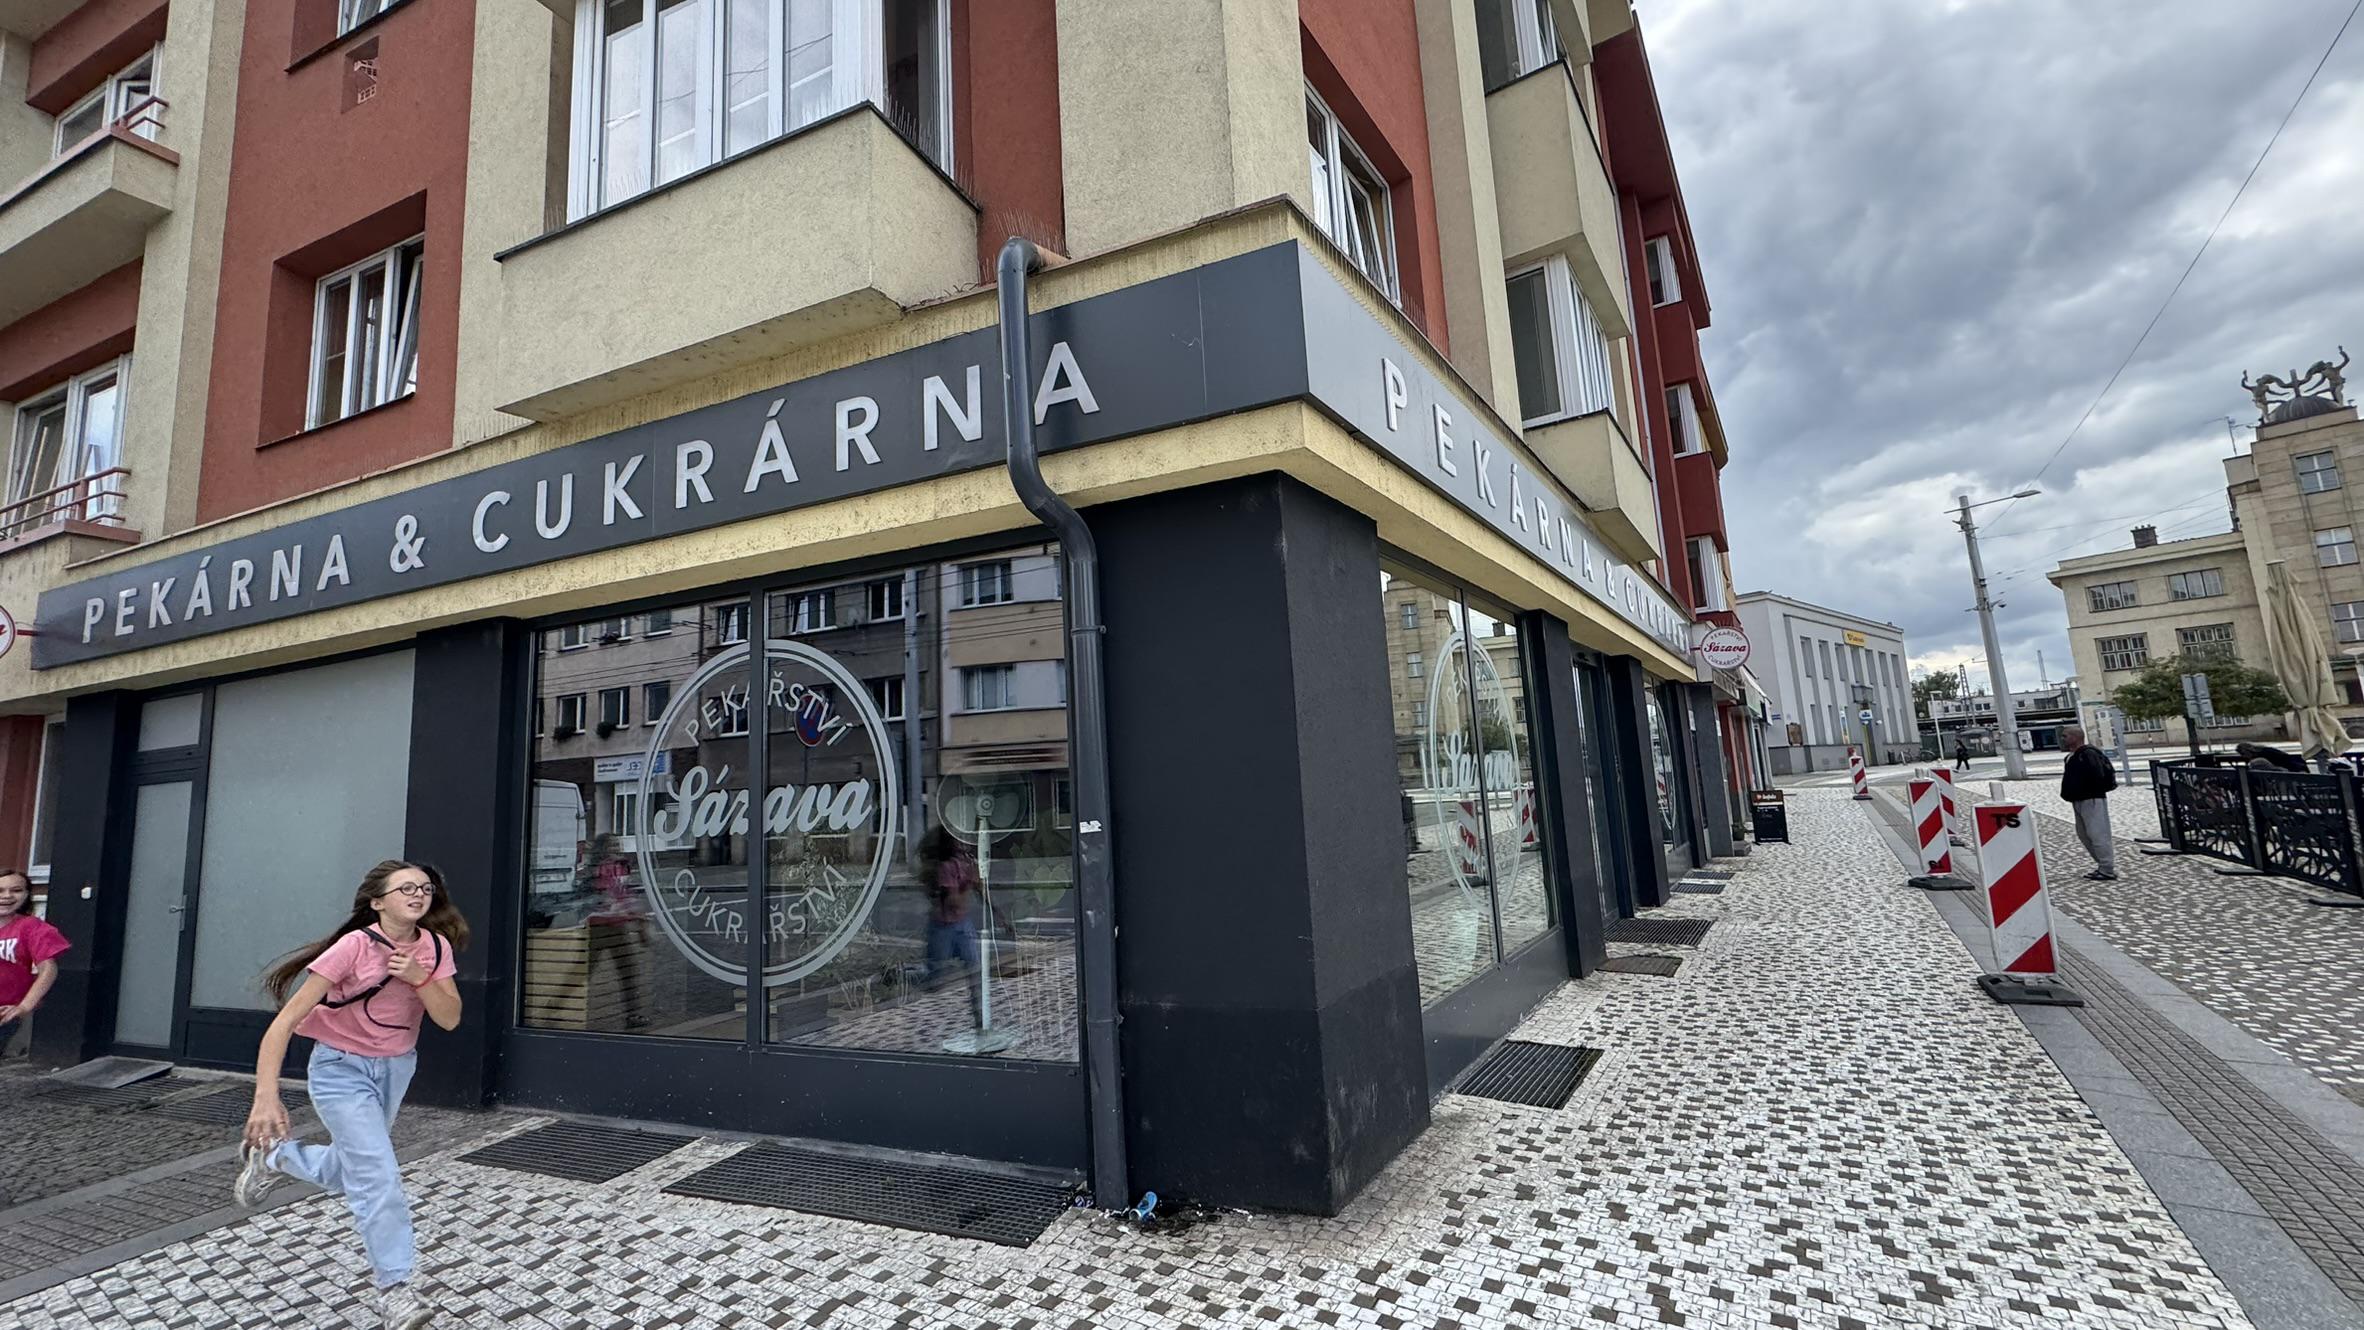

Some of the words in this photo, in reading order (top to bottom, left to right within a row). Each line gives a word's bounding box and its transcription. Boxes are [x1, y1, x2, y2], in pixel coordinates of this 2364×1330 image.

[82, 534, 350, 644] PEKÁRNA
[390, 514, 425, 572] &
[472, 341, 1100, 554] CUKRÁRNA
[1382, 358, 1594, 583] PEKÁRNA
[1604, 559, 1617, 600] &
[1704, 642, 1747, 653] Sázava
[1990, 812, 2022, 829] TS
